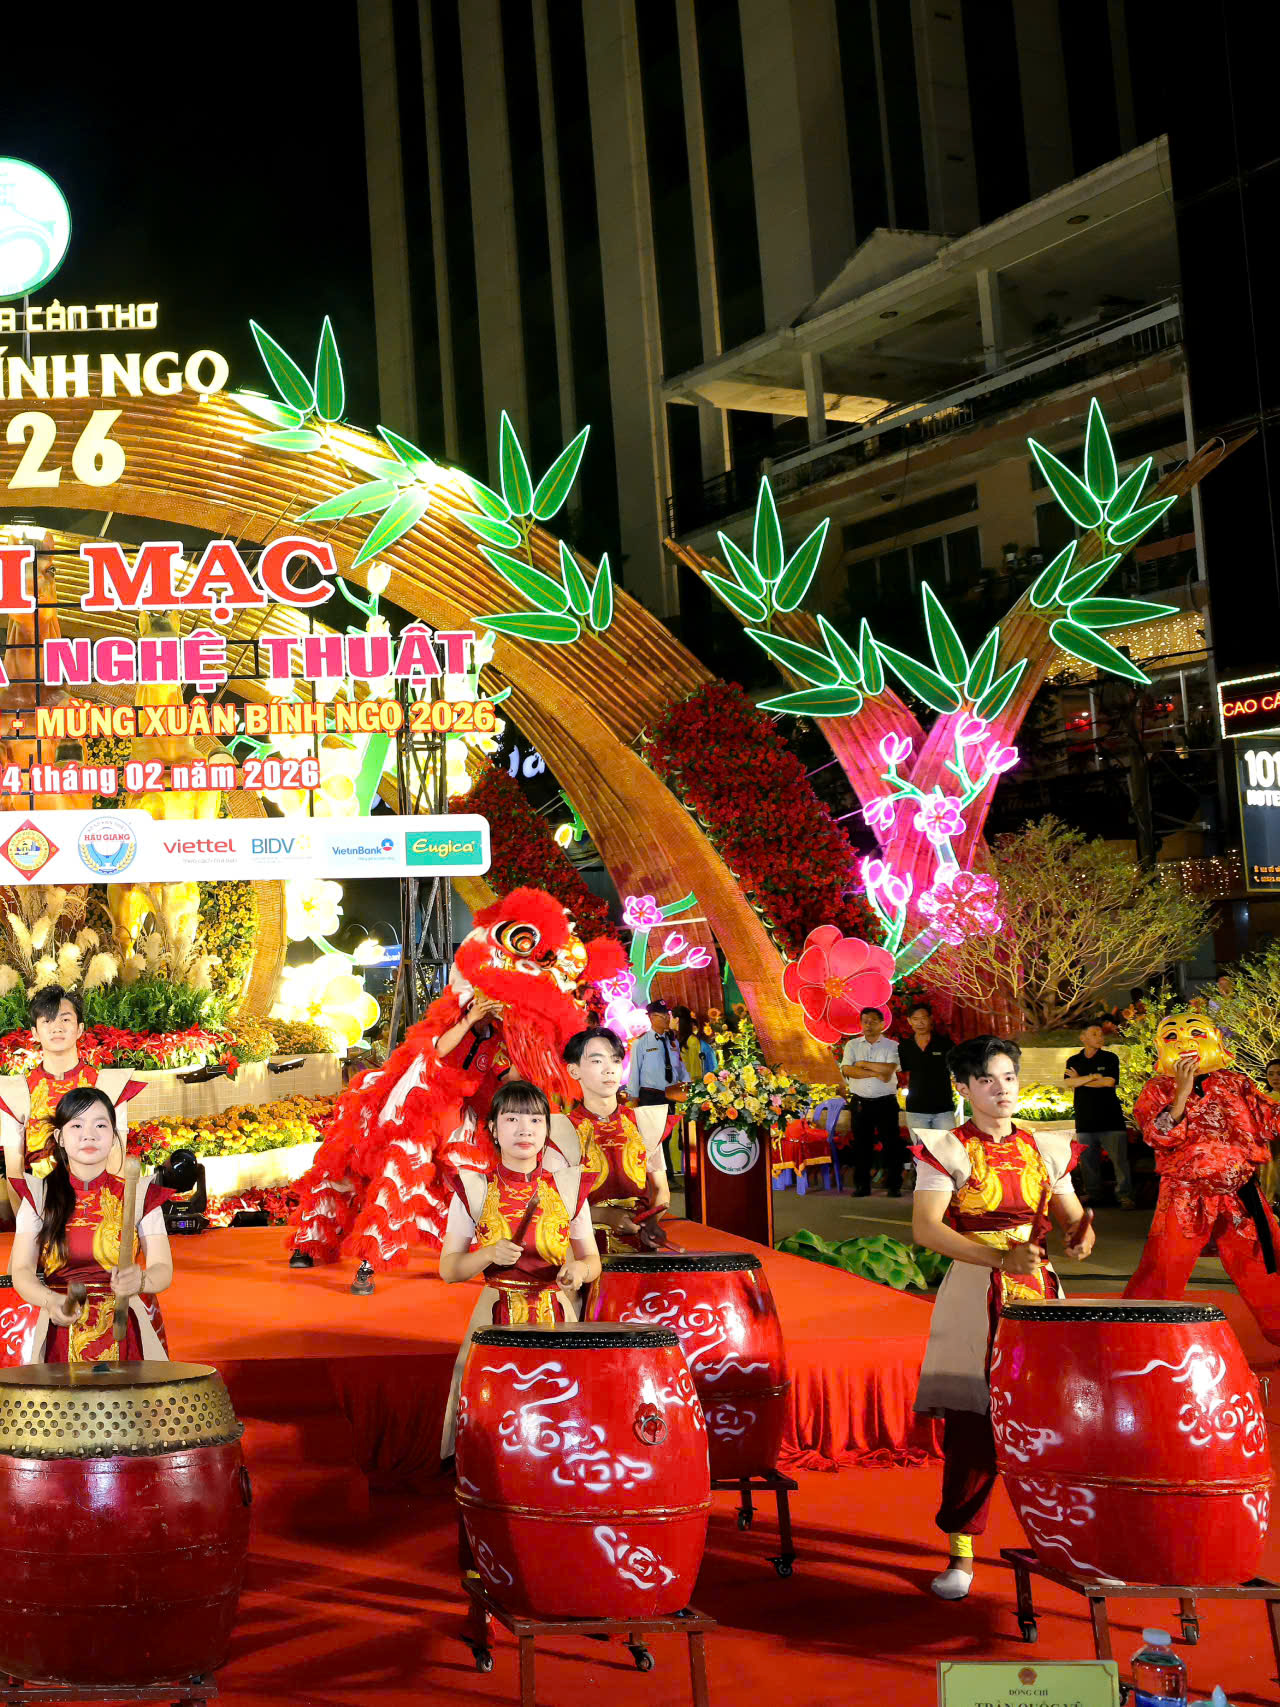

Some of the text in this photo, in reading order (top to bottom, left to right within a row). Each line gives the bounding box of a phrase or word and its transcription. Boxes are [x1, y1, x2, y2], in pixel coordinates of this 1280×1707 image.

[95, 302, 158, 329] THƠ
[100, 349, 229, 403] NGỌ
[80, 536, 337, 625] MẠC
[43, 627, 230, 694] NGHỆ
[258, 622, 476, 687] THUẬT
[36, 699, 135, 738] MỪNG
[140, 697, 235, 737] XUÂN
[243, 697, 332, 734] BÍNH
[335, 700, 403, 738] NGỌ
[409, 700, 497, 734] 2026
[1223, 699, 1258, 716] CAO
[29, 760, 119, 798] tháng
[123, 759, 167, 793] 02
[170, 758, 237, 791] năm
[242, 757, 321, 791] 2026
[163, 838, 237, 854] viettel
[251, 838, 295, 854] BIDV
[332, 846, 382, 856] VietinBank
[411, 838, 474, 859] Eugica
